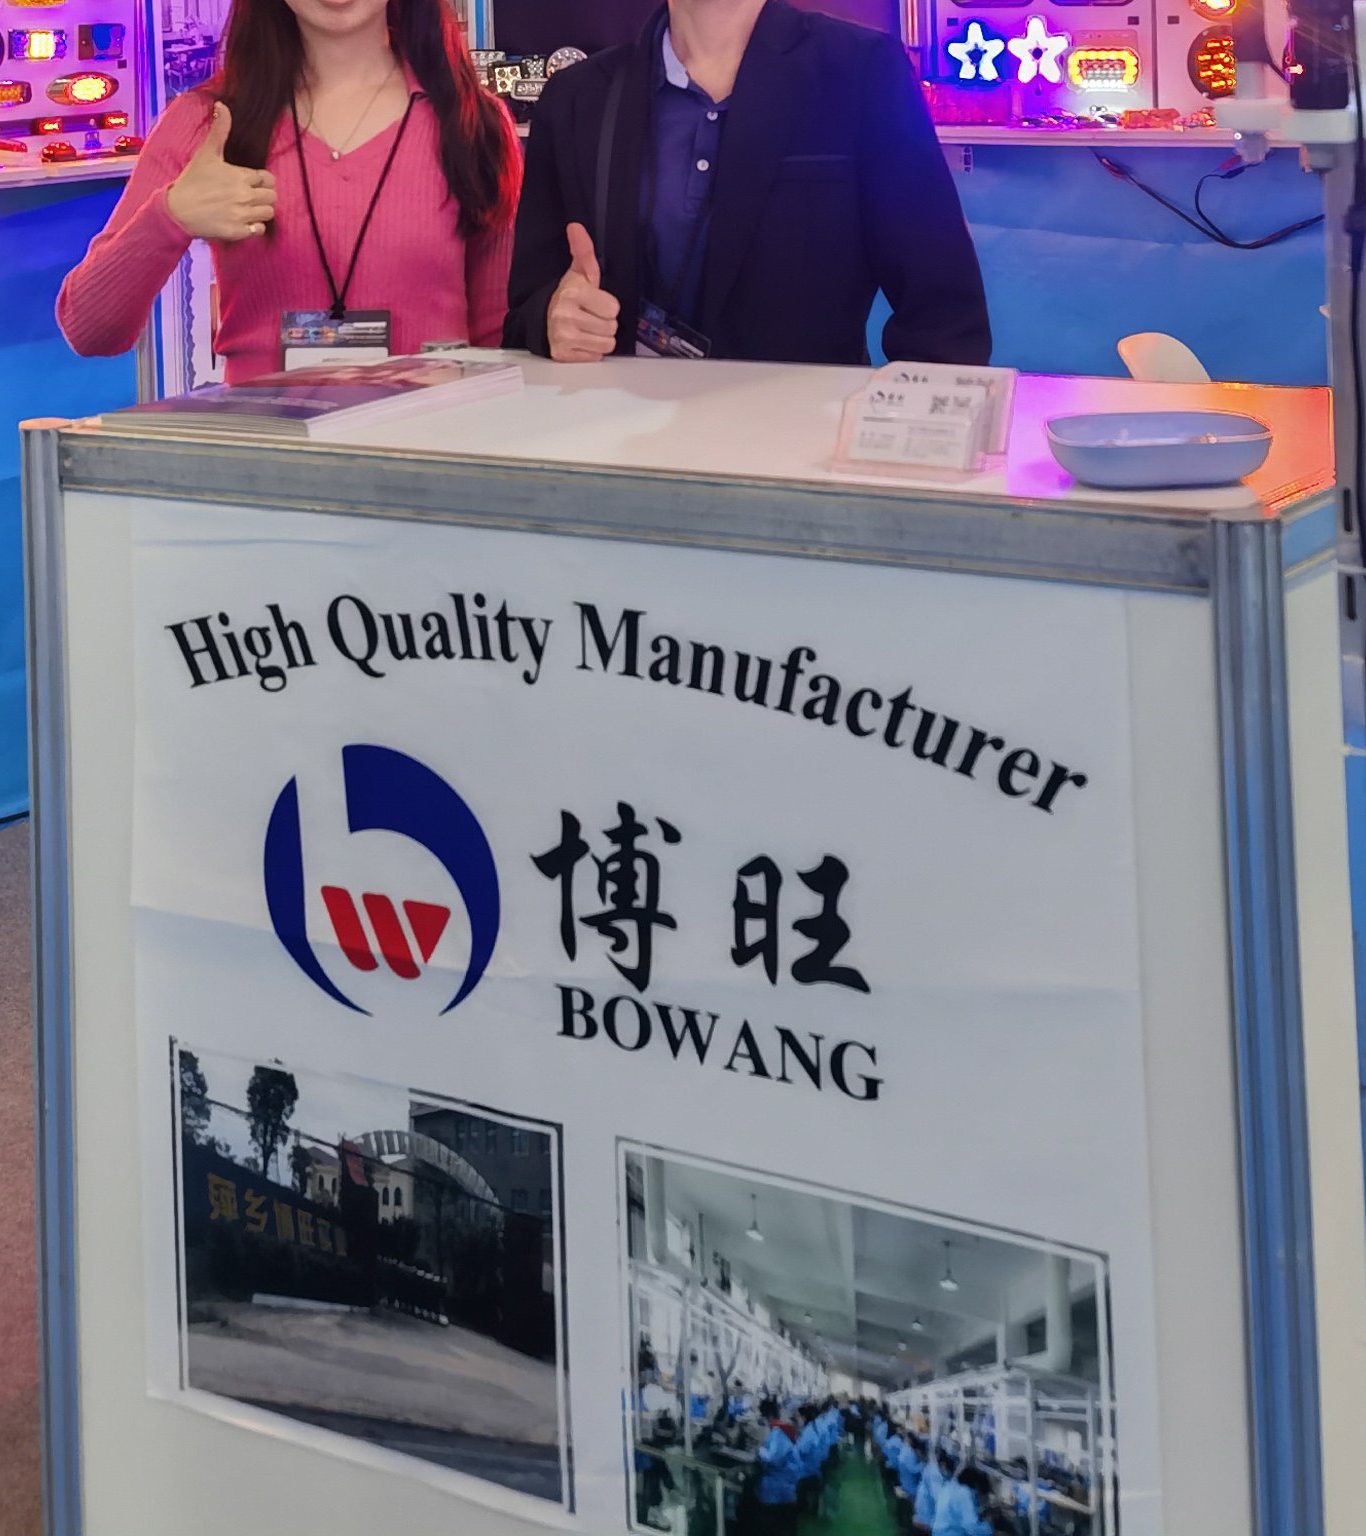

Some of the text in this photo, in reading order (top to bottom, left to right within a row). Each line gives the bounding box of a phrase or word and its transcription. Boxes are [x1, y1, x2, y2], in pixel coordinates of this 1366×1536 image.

[165, 592, 1088, 816] High Quality Manufacturer
[529, 800, 872, 993] 博旺
[554, 983, 885, 1102] BOWANG
